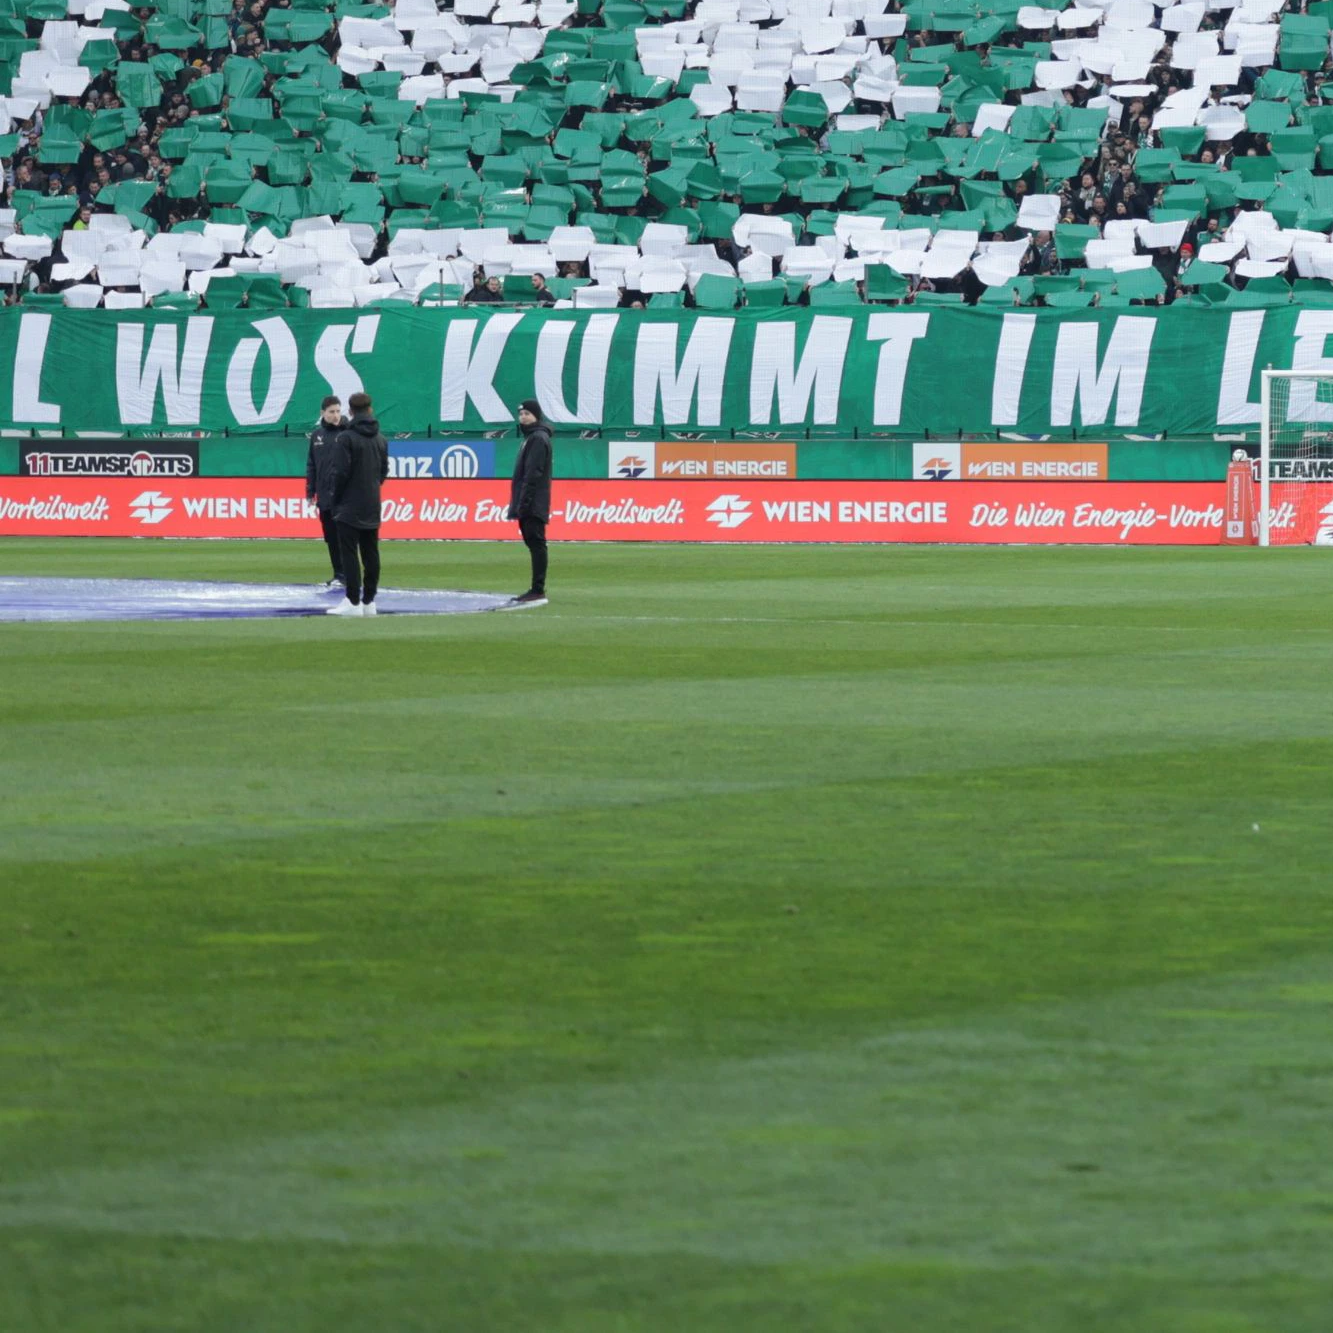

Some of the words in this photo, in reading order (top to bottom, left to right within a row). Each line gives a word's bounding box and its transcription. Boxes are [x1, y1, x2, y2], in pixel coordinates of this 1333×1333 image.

[116, 314, 380, 426] WOS
[440, 311, 930, 427] KUMMT
[990, 313, 1159, 427] IM
[26, 451, 193, 476] 11TEAMSPORTS
[662, 460, 707, 475] WIEN
[713, 460, 787, 475] ENERGIE
[968, 461, 1015, 477] WIEN
[1022, 461, 1098, 477] ENERGIE
[182, 498, 247, 518] WIEN
[254, 498, 319, 519] ENER
[380, 498, 408, 523] Die
[420, 498, 466, 523] Wien
[474, 497, 685, 535] Ene-Vorteilswelt.
[762, 501, 830, 523] WIEN
[839, 501, 948, 524] ENERGIE
[968, 502, 1008, 527] Die
[1014, 502, 1065, 527] Wien
